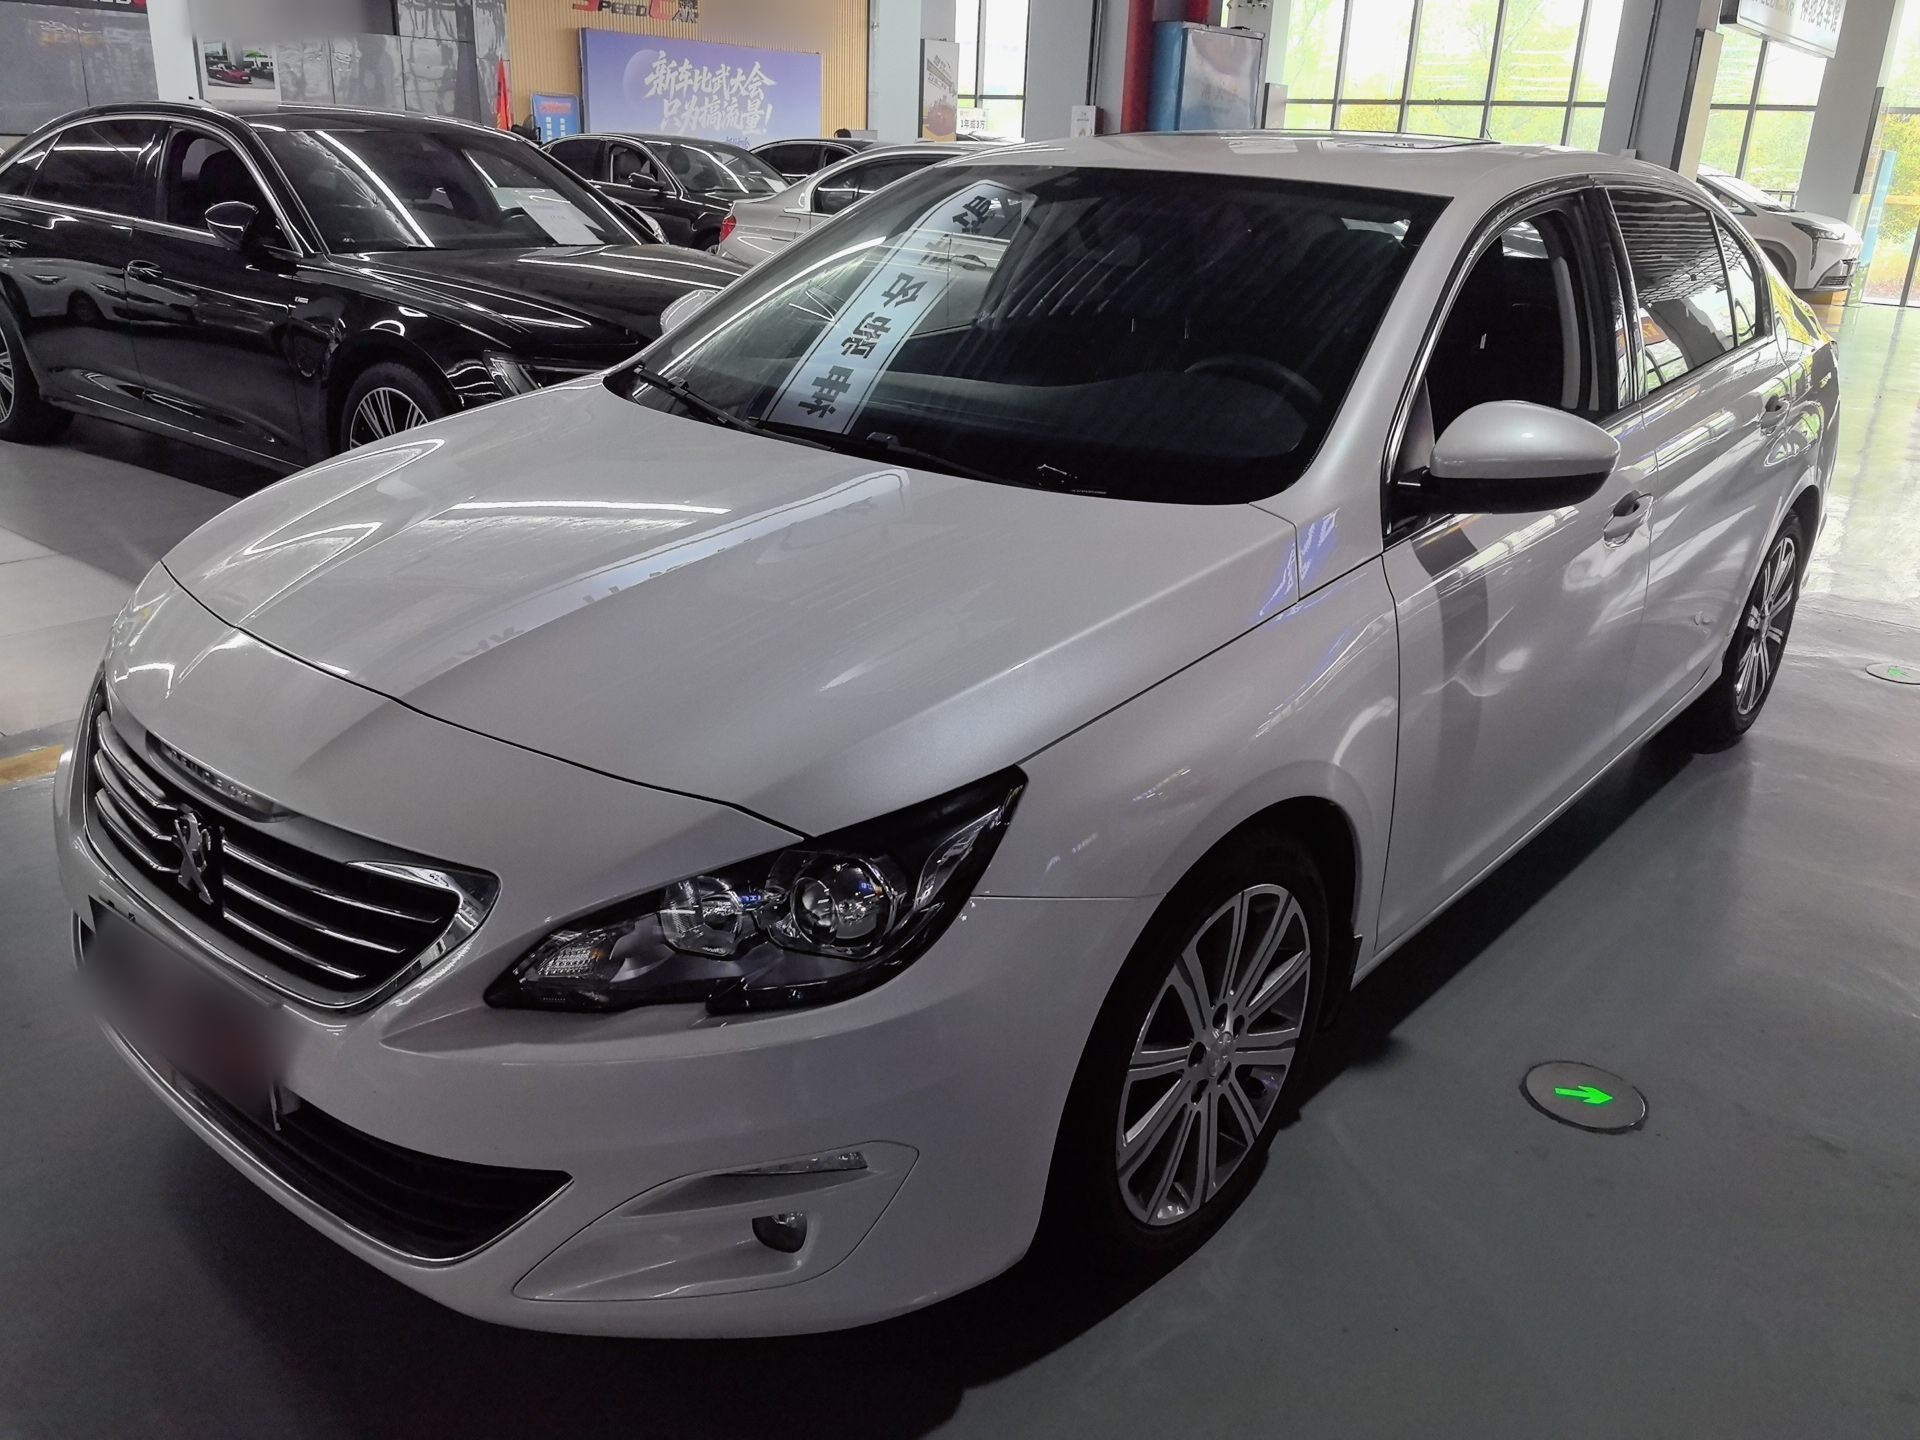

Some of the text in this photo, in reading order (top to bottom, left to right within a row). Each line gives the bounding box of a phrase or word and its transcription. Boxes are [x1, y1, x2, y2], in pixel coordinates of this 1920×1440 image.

[643, 50, 777, 100] 新车比武大会
